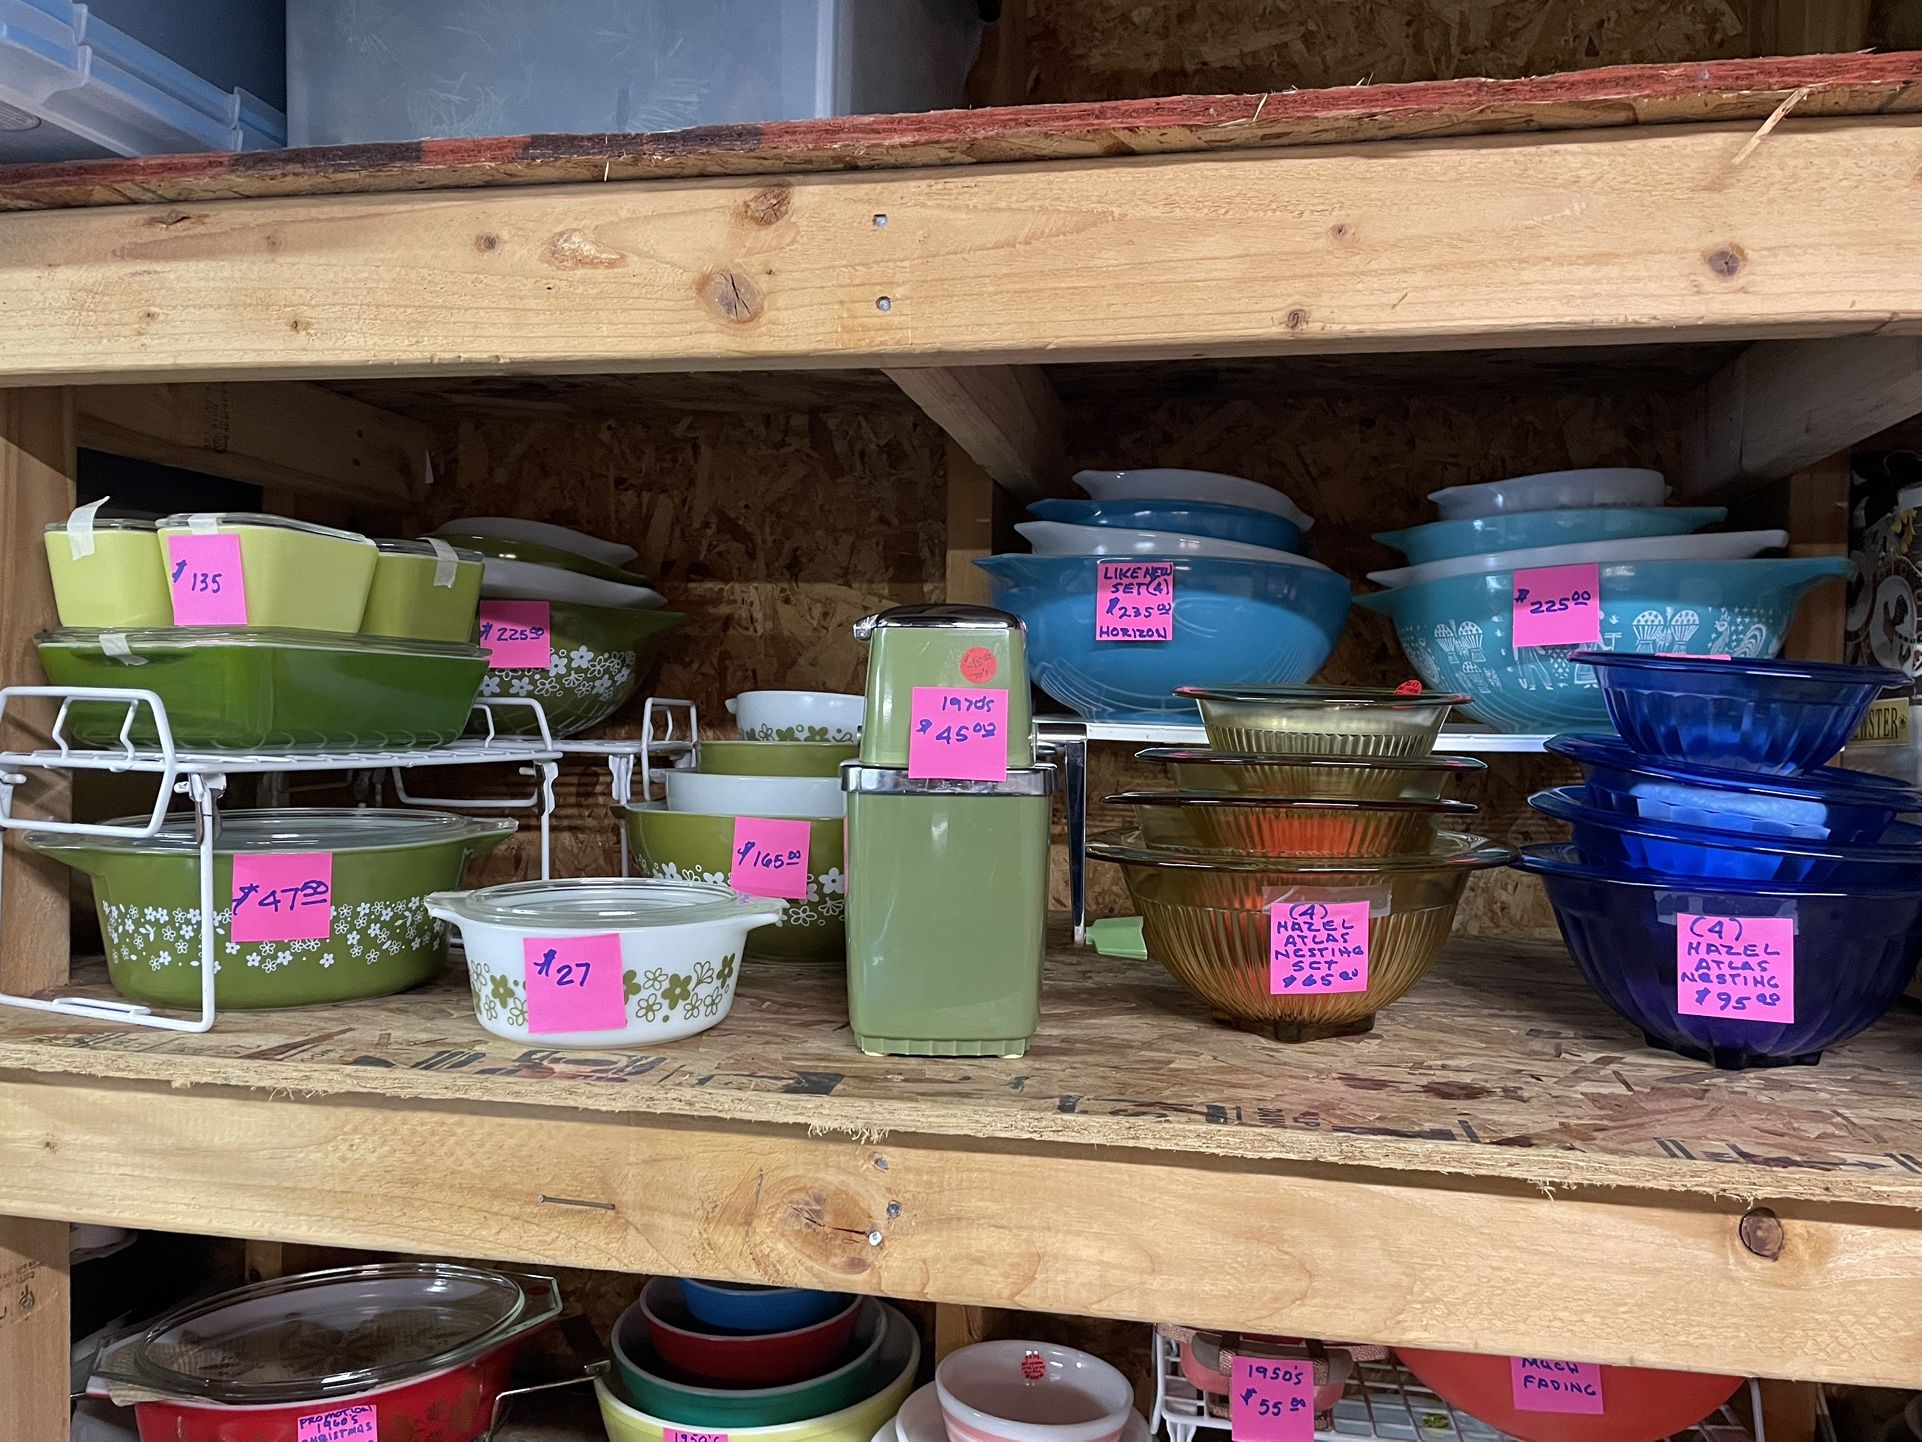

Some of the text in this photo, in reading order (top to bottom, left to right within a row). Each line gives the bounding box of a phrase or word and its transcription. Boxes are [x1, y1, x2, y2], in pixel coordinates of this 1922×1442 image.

[1104, 566, 1142, 580] LIKE
[1100, 625, 1168, 640] HORIZON
[1289, 904, 1329, 921] (4)
[1277, 918, 1355, 935] HAZEL
[1689, 916, 1743, 942] (4)
[1284, 932, 1350, 948] ATLAS
[1275, 945, 1365, 961] NESTING
[1687, 941, 1781, 957] HAZEL
[1694, 957, 1770, 973] ATLAS
[1681, 971, 1780, 989] NESTING
[1522, 1357, 1579, 1375] MUCH
[1523, 1374, 1597, 1396] FADING
